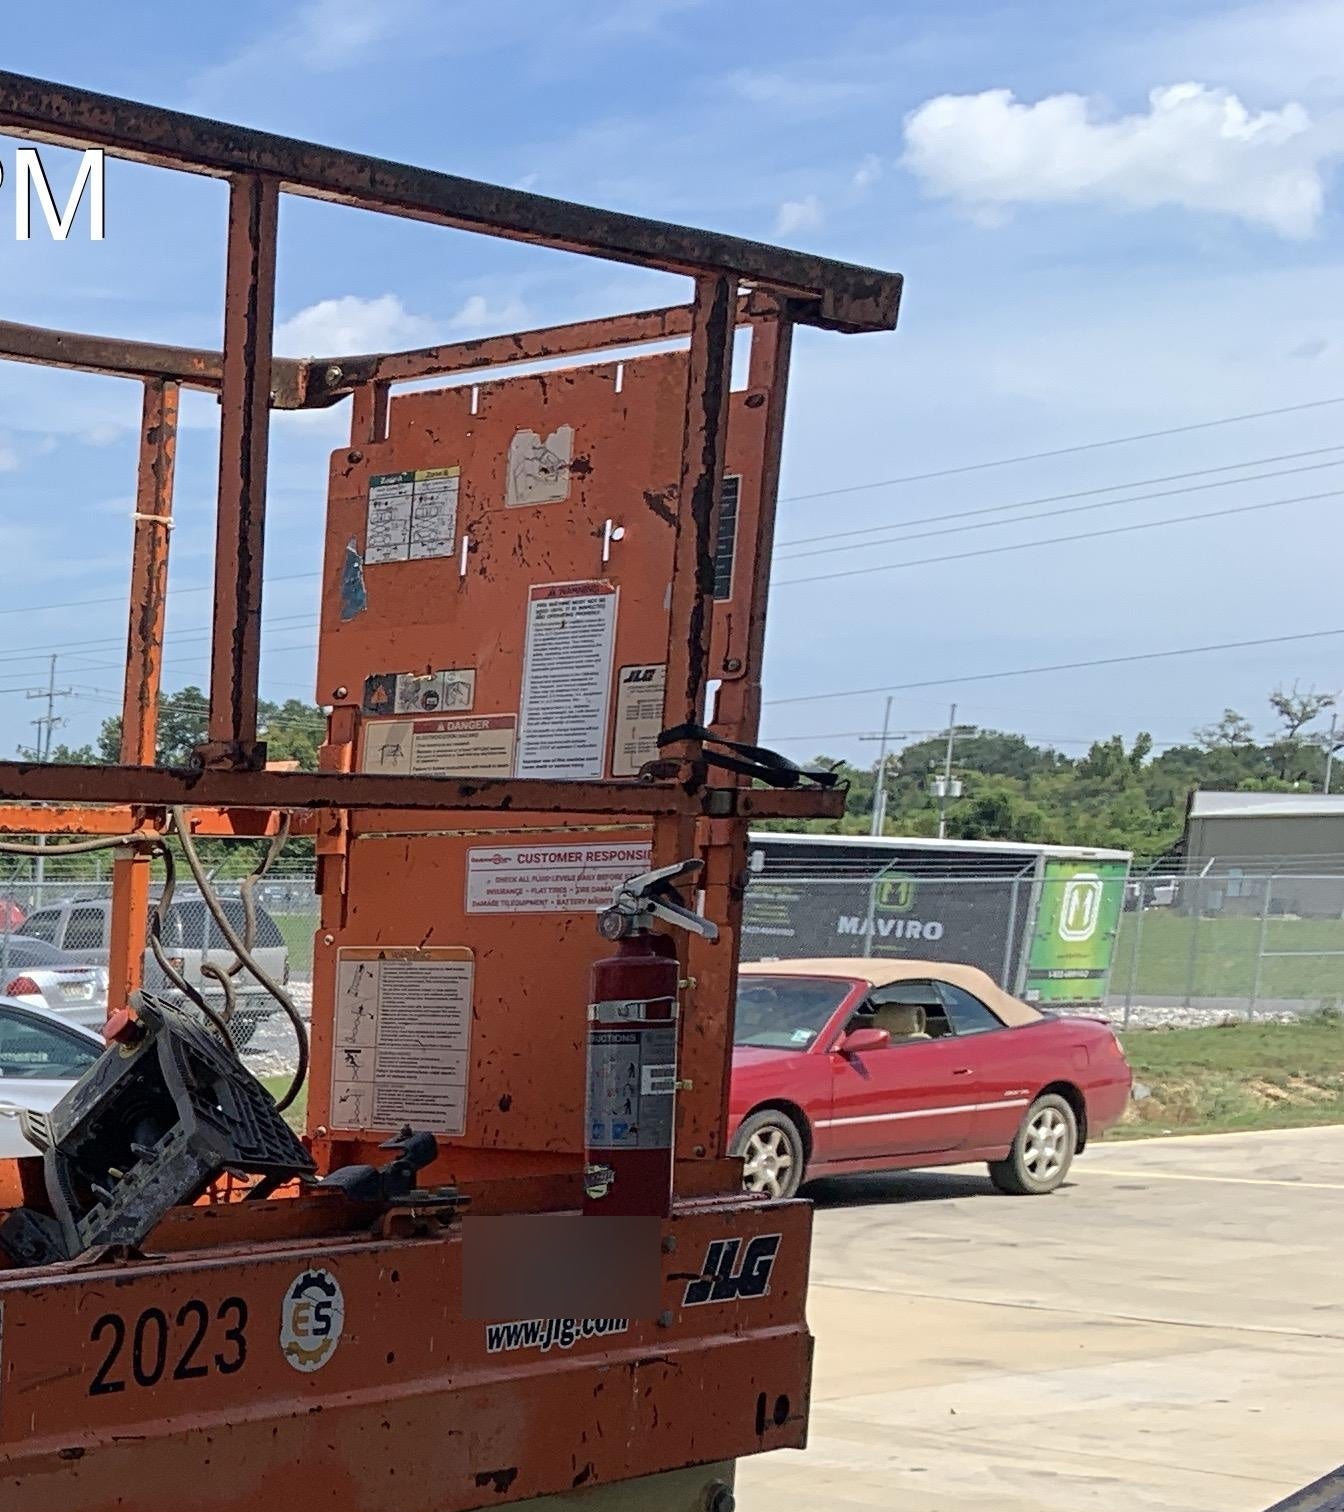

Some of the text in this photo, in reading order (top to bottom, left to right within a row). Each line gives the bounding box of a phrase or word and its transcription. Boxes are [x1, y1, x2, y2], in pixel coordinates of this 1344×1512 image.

[623, 669, 657, 683] JLG
[447, 720, 489, 731] DANGER
[517, 852, 582, 864] CUSTOMER
[837, 915, 945, 940] MAVIRO
[681, 1233, 783, 1307] JLG
[89, 1296, 249, 1397] 2023
